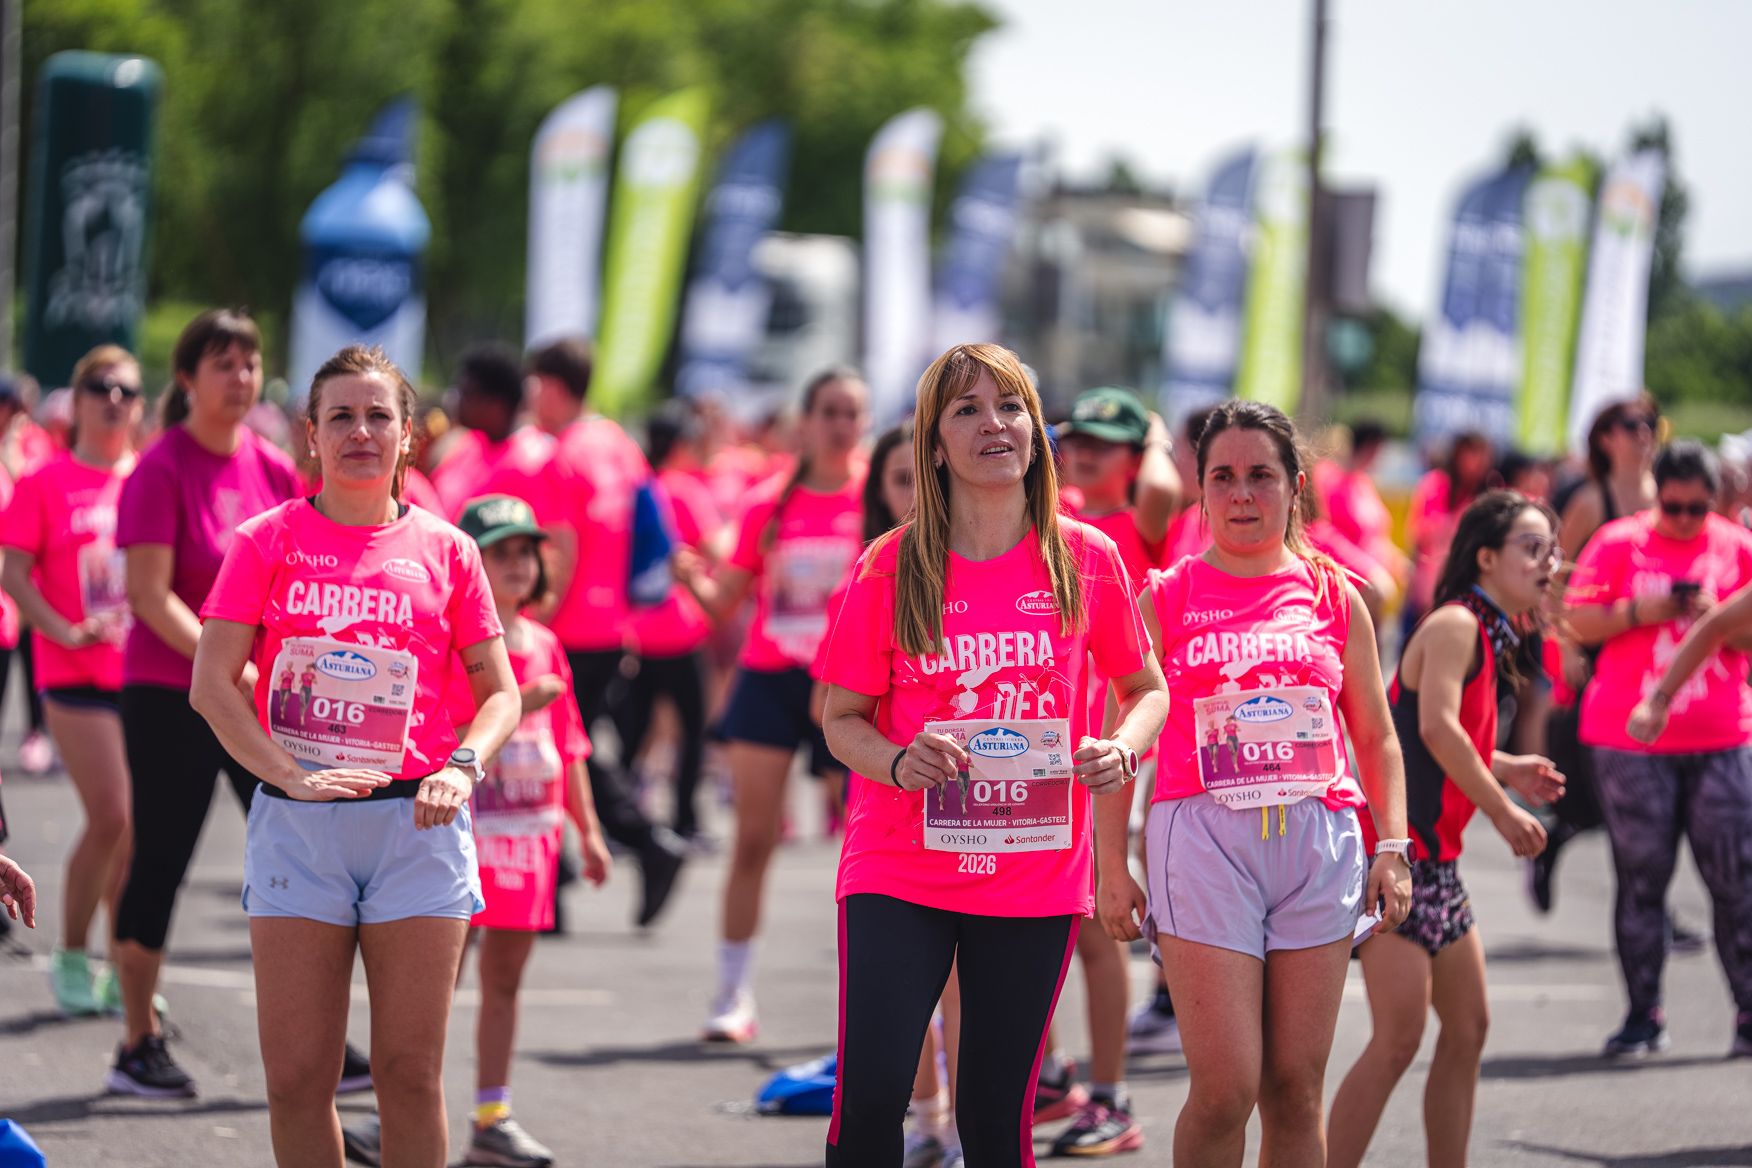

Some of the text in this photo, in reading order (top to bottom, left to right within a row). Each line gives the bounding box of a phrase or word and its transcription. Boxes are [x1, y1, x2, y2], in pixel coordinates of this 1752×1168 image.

[286, 579, 414, 629] CARRERA
[1182, 608, 1234, 626] OYSHO
[1186, 631, 1313, 668] CARRERA
[319, 657, 373, 677] ASTURIANA
[312, 697, 366, 724] 016
[1238, 706, 1290, 719] ASTURIANA
[327, 723, 348, 735] 463
[272, 723, 401, 752] CARRERA DE LA MUJER VITORIA-GASTEIZ
[973, 738, 1025, 750] ASTURIANA
[283, 738, 322, 758] OYSHO
[1242, 741, 1295, 762] 016
[346, 752, 387, 766] Santander
[1262, 762, 1282, 772] 464
[1206, 777, 1236, 789] CARRERA
[1236, 776, 1246, 785] DE
[1246, 775, 1255, 784] LA
[1255, 774, 1279, 783] MUJER
[973, 781, 1029, 803] 016
[1218, 789, 1262, 804] OYSHO
[992, 806, 1012, 816] 498
[929, 815, 1067, 827] CARRERA DE LA MUJER VITORIA-GASTEIZ
[940, 833, 988, 846] OYSHO
[1015, 833, 1056, 845] Santander
[957, 853, 997, 875] 2026
